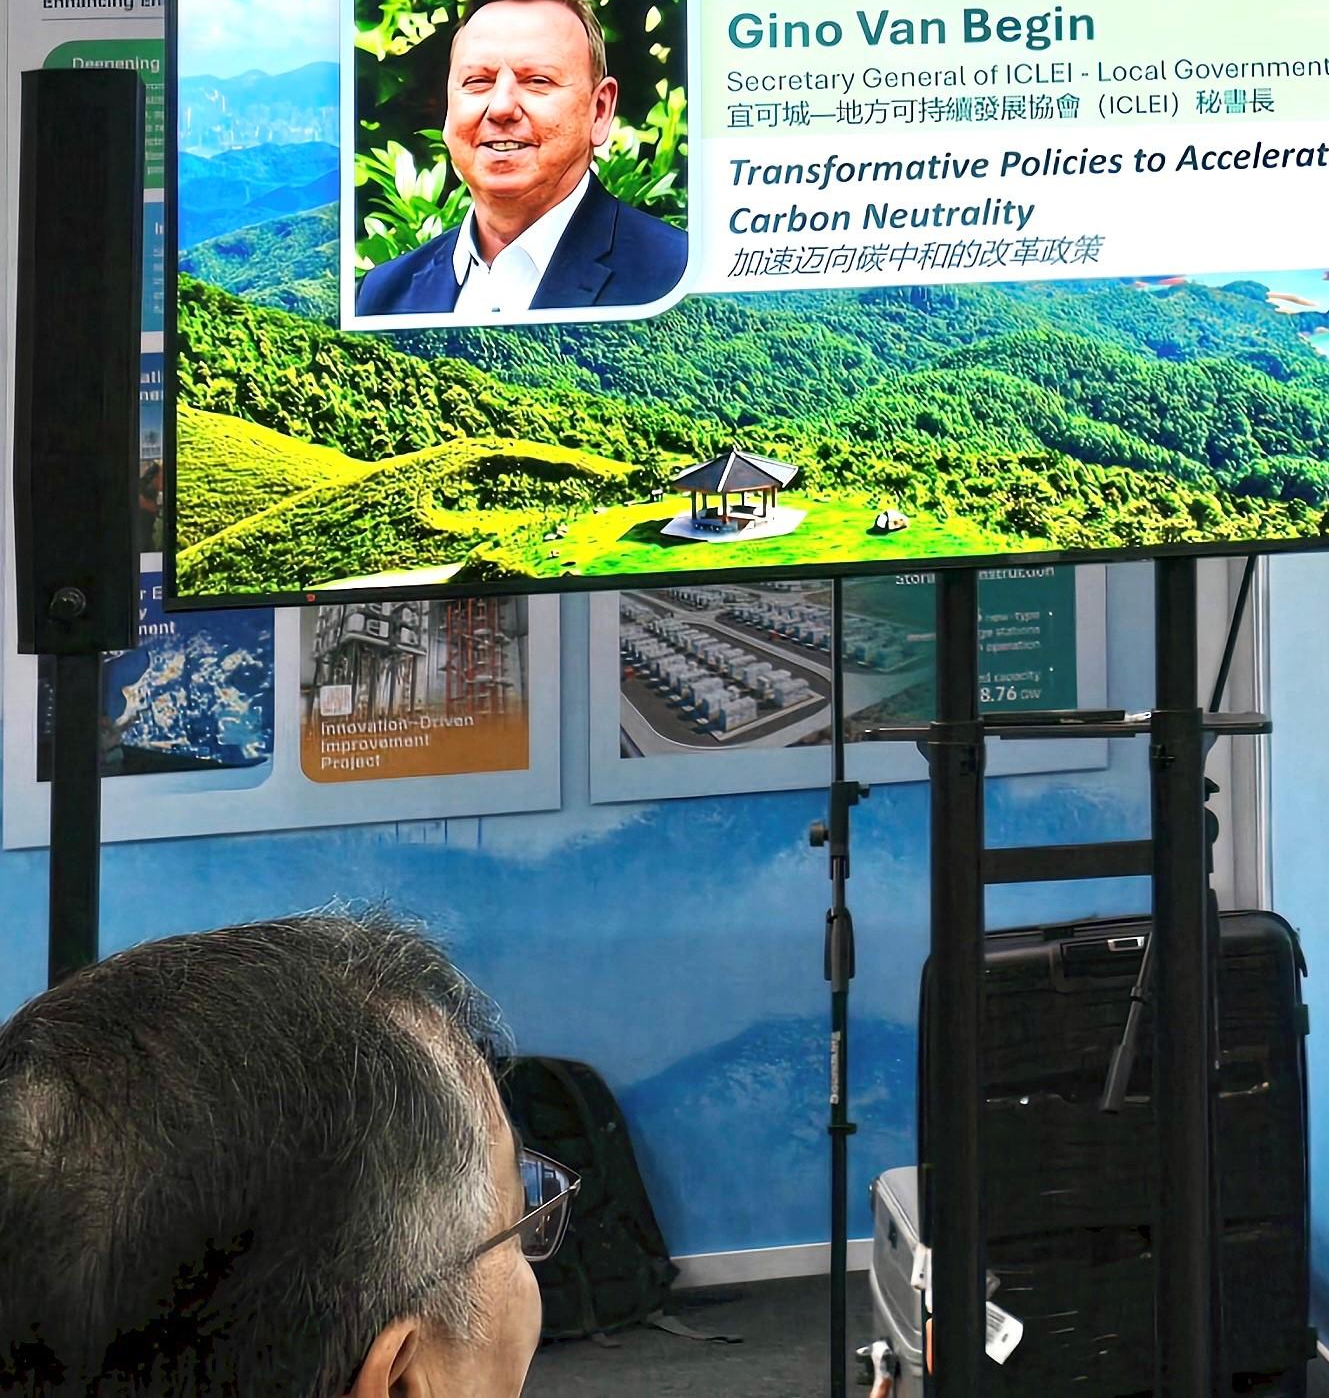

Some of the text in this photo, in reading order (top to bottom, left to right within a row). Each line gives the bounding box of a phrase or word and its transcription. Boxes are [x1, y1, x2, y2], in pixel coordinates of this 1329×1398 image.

[727, 6, 1095, 51] Gino Van Begin
[727, 68, 855, 94] Secretary
[863, 64, 964, 88] General
[974, 64, 997, 85] of
[1006, 63, 1072, 84] ICLEI
[1097, 60, 1167, 82] Local
[729, 151, 989, 191] Transformative
[1000, 148, 1123, 177] Policies
[1134, 147, 1166, 173] to
[728, 198, 1035, 235] Carbon Neutrality
[322, 715, 474, 736] Innovation-Driven
[322, 734, 430, 753] Improvement
[322, 755, 381, 770] Project
